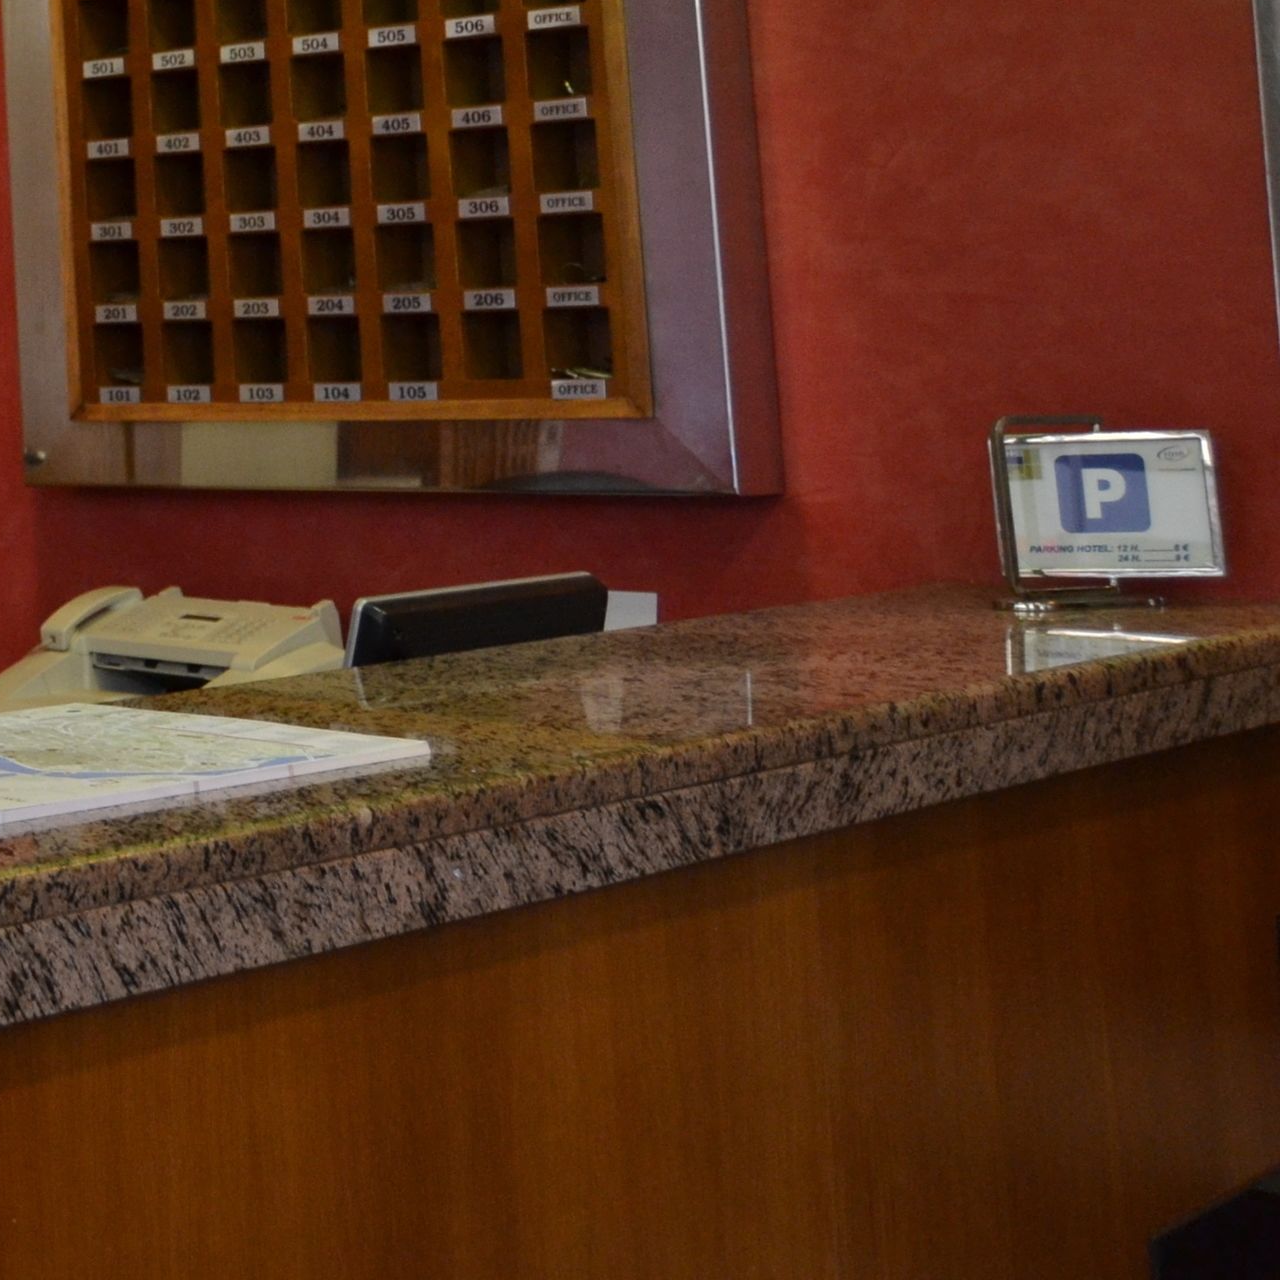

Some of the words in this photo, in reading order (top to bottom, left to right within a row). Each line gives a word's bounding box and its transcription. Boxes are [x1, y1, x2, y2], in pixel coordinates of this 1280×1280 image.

[533, 11, 573, 25] OFFICE
[454, 19, 485, 34] 506
[376, 29, 406, 43] 505
[301, 38, 329, 51] 504
[160, 53, 186, 66] 502
[229, 47, 256, 60] 503
[91, 62, 115, 75] 501
[540, 103, 580, 117] OFFICE
[461, 110, 492, 124] 406
[306, 124, 334, 137] 404
[381, 118, 410, 132] 405
[164, 136, 190, 149] 402
[234, 130, 261, 143] 403
[96, 142, 119, 155] 401
[468, 200, 500, 214] 306
[546, 196, 586, 209] OFFICE
[312, 211, 340, 224] 304
[386, 208, 416, 221] 305
[169, 222, 194, 234] 302
[240, 216, 266, 229] 303
[99, 226, 123, 238] 301
[392, 296, 421, 310] 205
[473, 292, 505, 307] 206
[552, 290, 592, 303] OFFICE
[171, 305, 197, 317] 202
[242, 302, 269, 315] 203
[316, 299, 344, 312] 204
[103, 308, 127, 320] 201
[107, 390, 131, 402] 101
[176, 389, 200, 402] 102
[249, 387, 274, 400] 103
[323, 387, 350, 400] 104
[398, 386, 426, 400] 105
[558, 384, 598, 396] OFFICE
[1081, 468, 1126, 519] P
